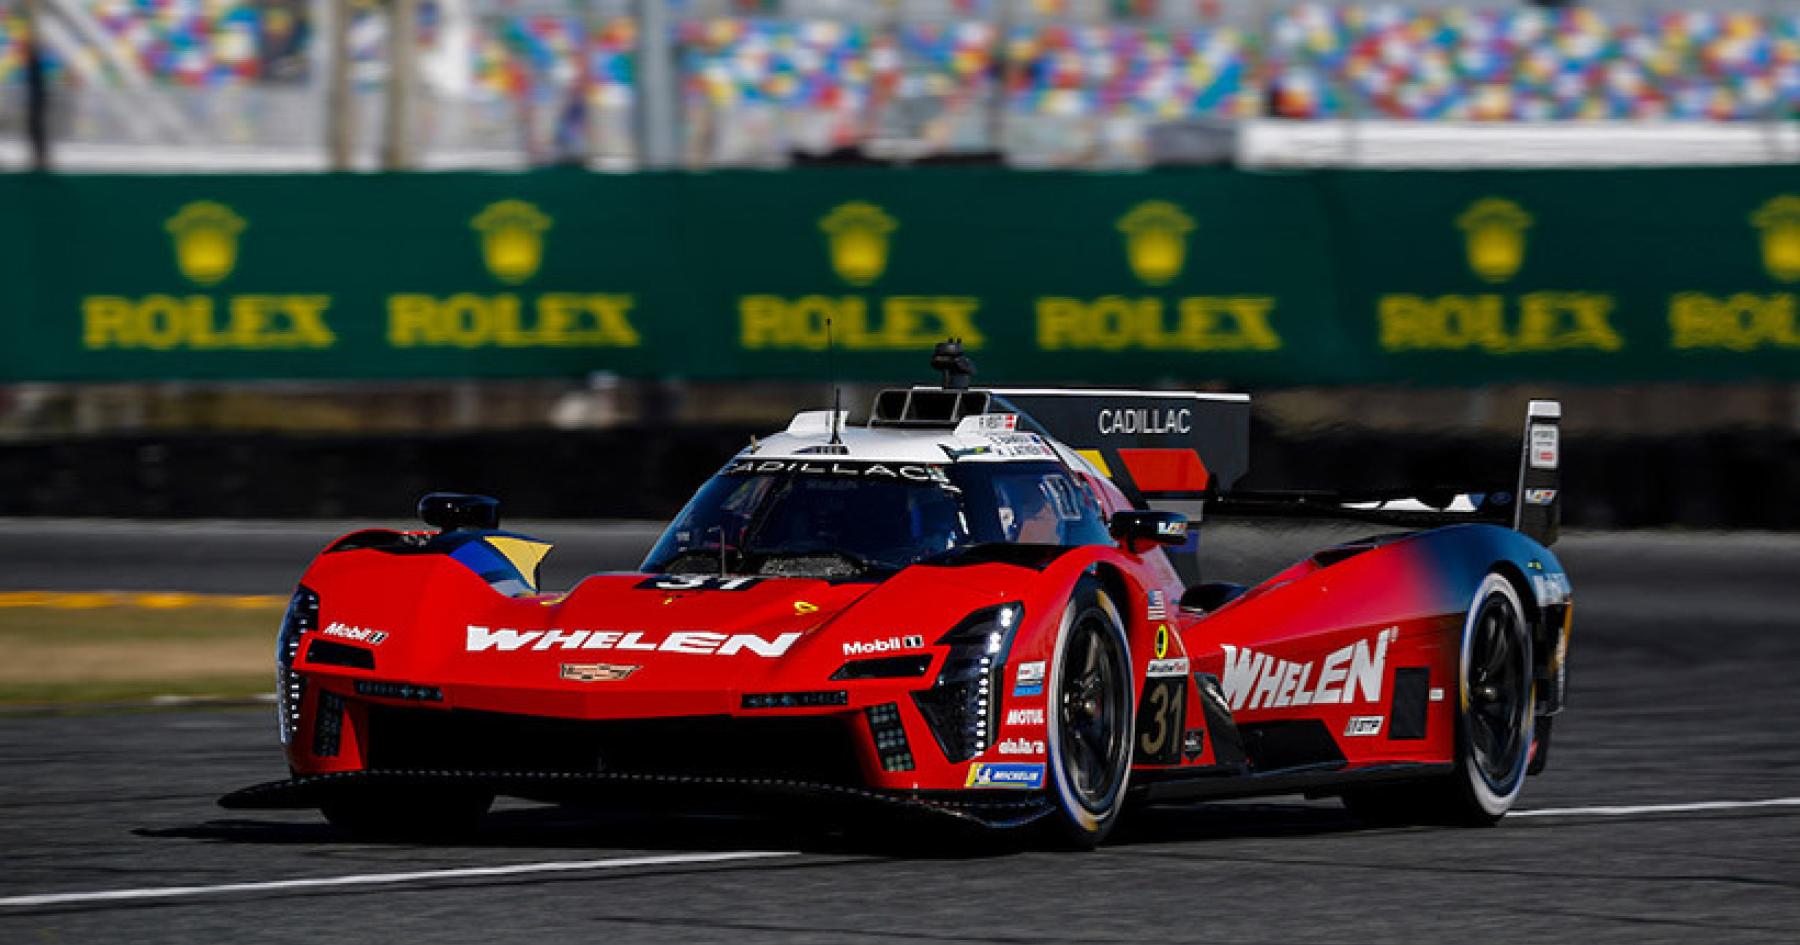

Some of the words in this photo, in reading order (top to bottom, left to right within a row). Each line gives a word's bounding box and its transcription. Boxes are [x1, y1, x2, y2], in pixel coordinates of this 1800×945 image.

[83, 295, 333, 348] ROLEX
[389, 294, 638, 347] ROLEX
[739, 295, 982, 348] ROLEX
[1036, 296, 1279, 349] ROLEX
[1379, 293, 1621, 350] ROLEX
[1099, 408, 1191, 434] CADILLAC
[322, 621, 372, 641] Mobil
[466, 624, 802, 658] WHELEN
[842, 637, 901, 656] Mobil
[1220, 627, 1390, 711] WHELEN
[1006, 709, 1044, 725] MOTUL
[1141, 682, 1185, 756] 31
[993, 770, 1040, 782] MICHELIN
